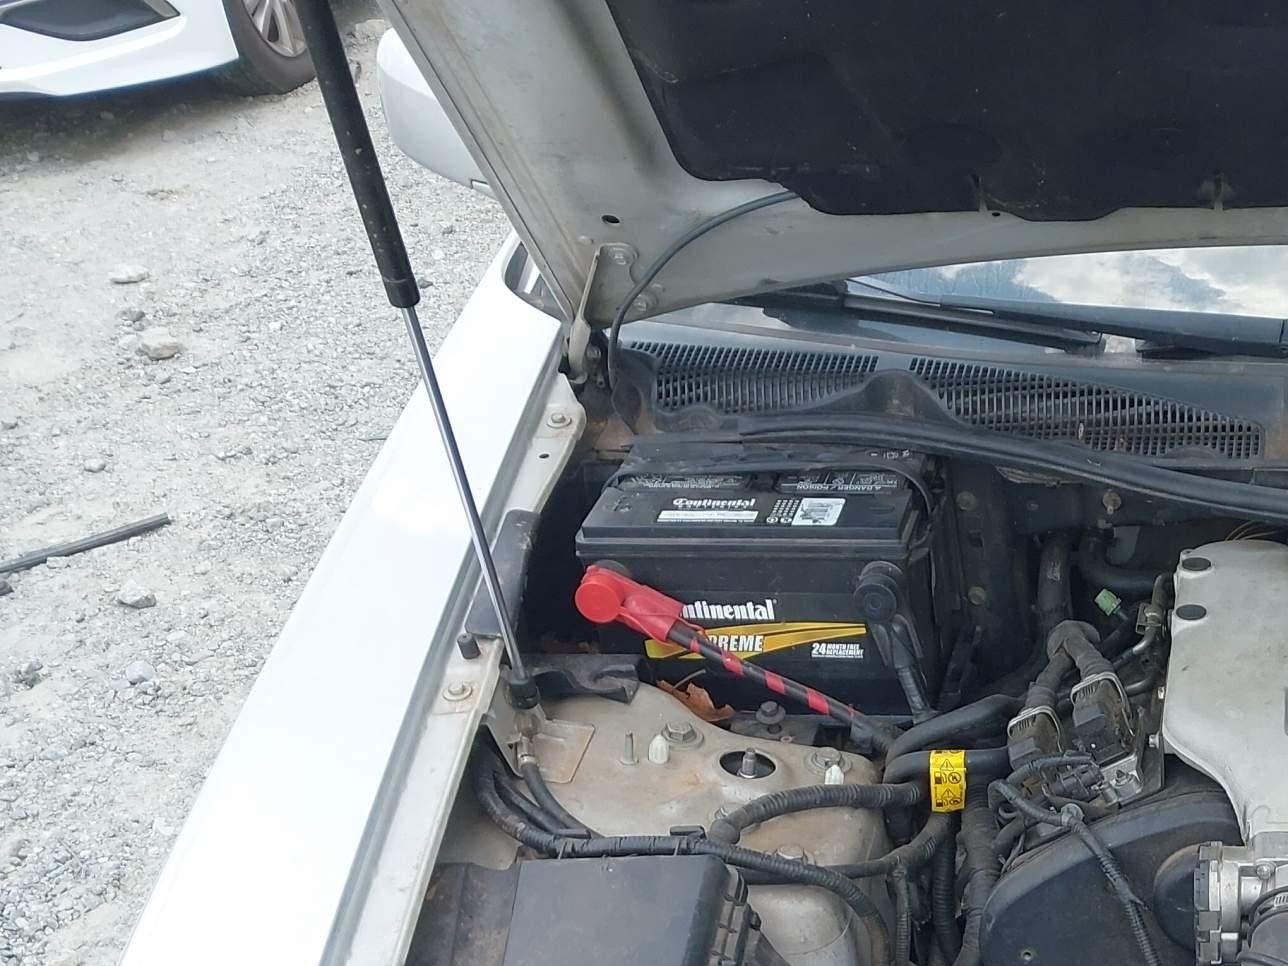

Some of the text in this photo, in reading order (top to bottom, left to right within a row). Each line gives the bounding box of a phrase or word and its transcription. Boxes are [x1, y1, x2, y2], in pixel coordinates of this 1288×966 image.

[672, 498, 756, 508] Continental
[681, 599, 775, 620] ntinental
[707, 635, 765, 653] PREME
[811, 643, 826, 655] 24
